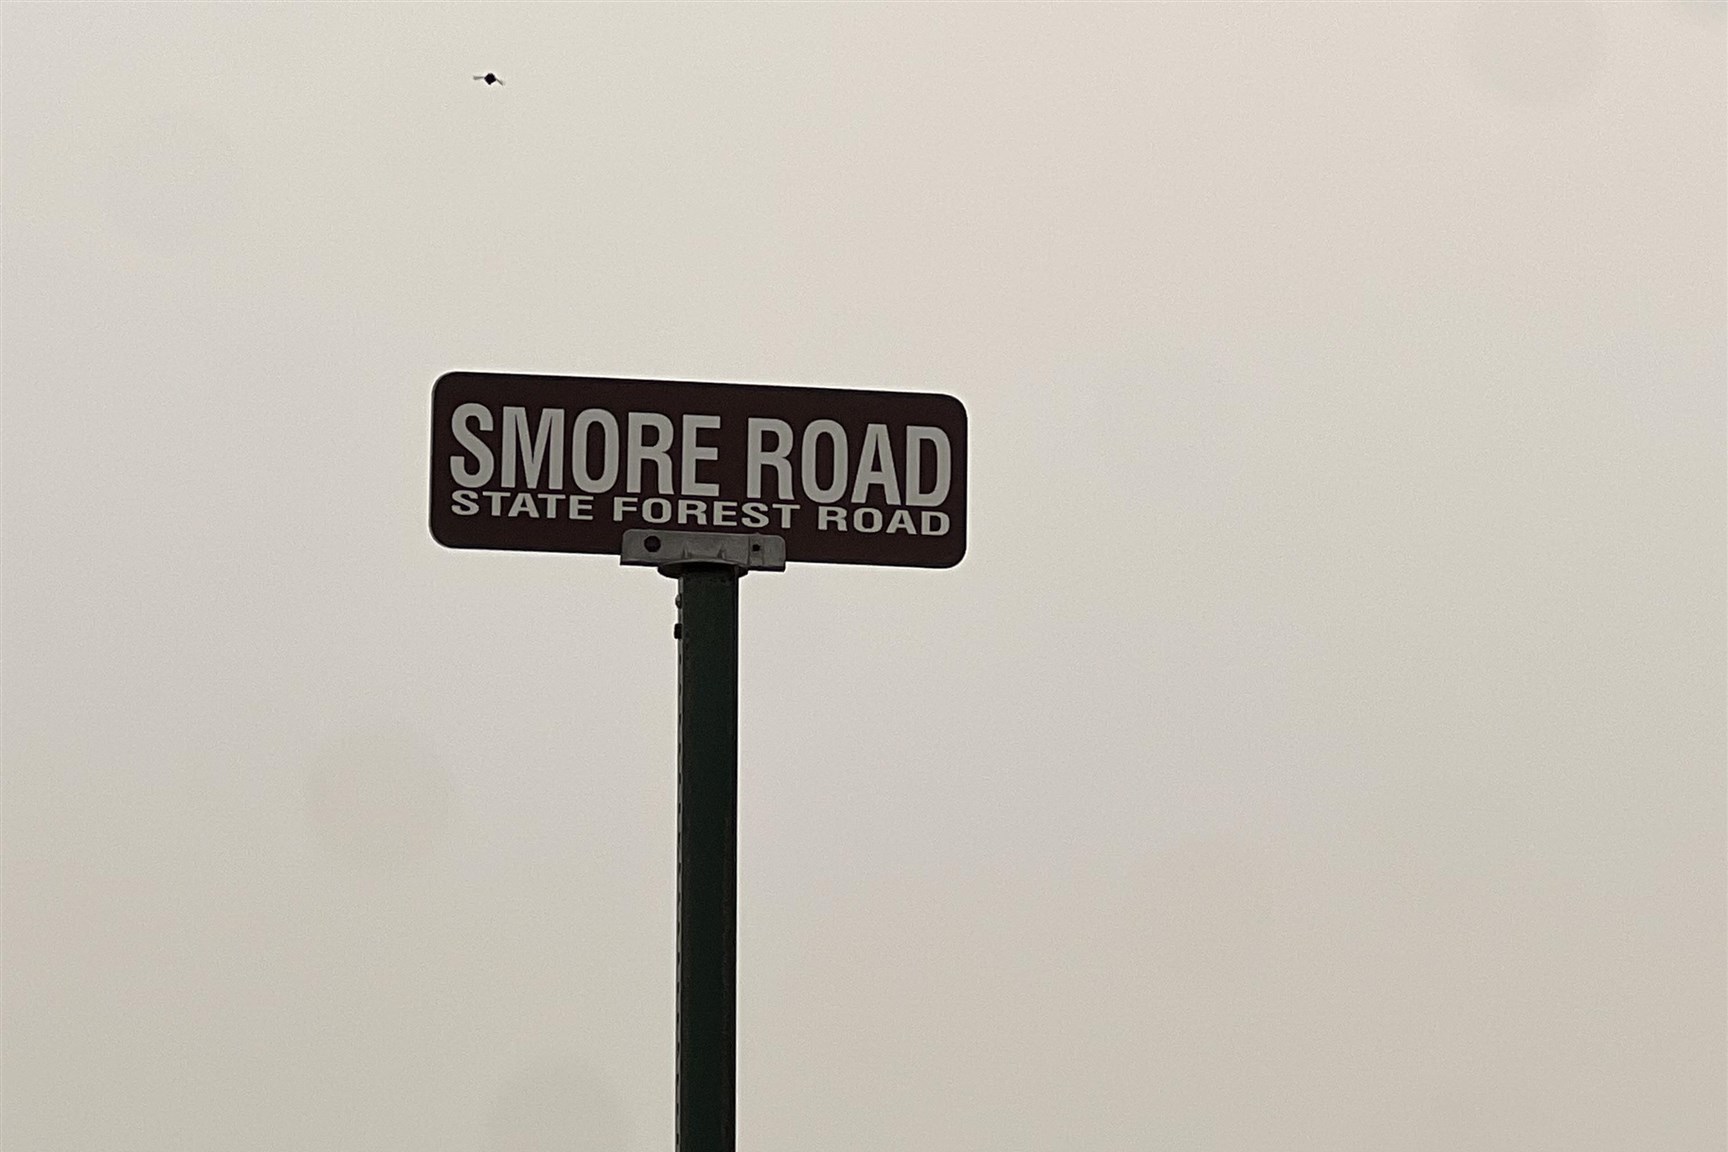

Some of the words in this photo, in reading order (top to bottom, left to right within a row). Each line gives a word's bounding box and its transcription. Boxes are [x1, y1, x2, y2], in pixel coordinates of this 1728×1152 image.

[450, 403, 721, 497] SMORE
[746, 417, 952, 507] ROAD
[450, 490, 595, 520] STATE
[612, 496, 801, 529] FOREST
[817, 506, 951, 536] ROAD
